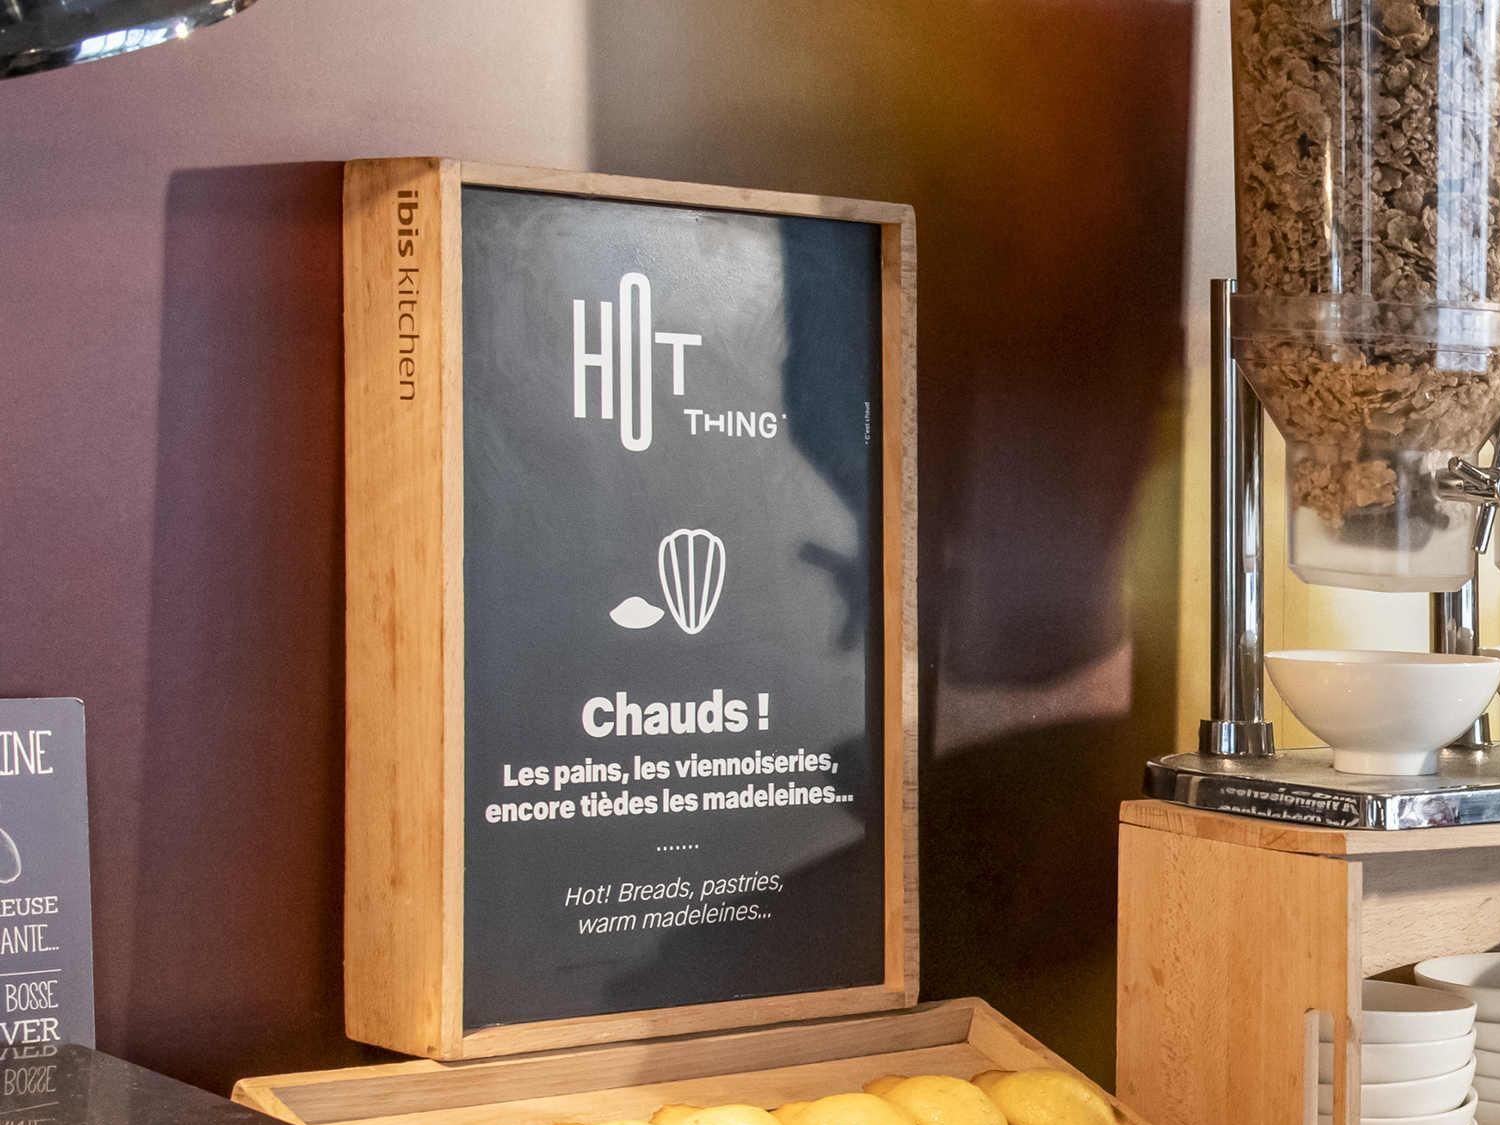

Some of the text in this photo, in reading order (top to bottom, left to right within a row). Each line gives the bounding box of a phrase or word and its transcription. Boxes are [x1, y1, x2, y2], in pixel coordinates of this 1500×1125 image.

[396, 189, 421, 402] ibis kitchen
[573, 272, 702, 452] HOT
[581, 689, 749, 738] Chauds
[0, 730, 54, 776] INE
[503, 748, 840, 792] Les pains, les viennoiseries,
[485, 781, 855, 825] encore tièdes les madeleines...
[0, 896, 59, 917] EUSE
[564, 870, 785, 908] Hot! Breads, pastries,
[0, 924, 60, 955] ANTE...
[578, 913, 638, 936] warm
[5, 980, 59, 1012] BOSSE
[0, 1017, 61, 1046] VER
